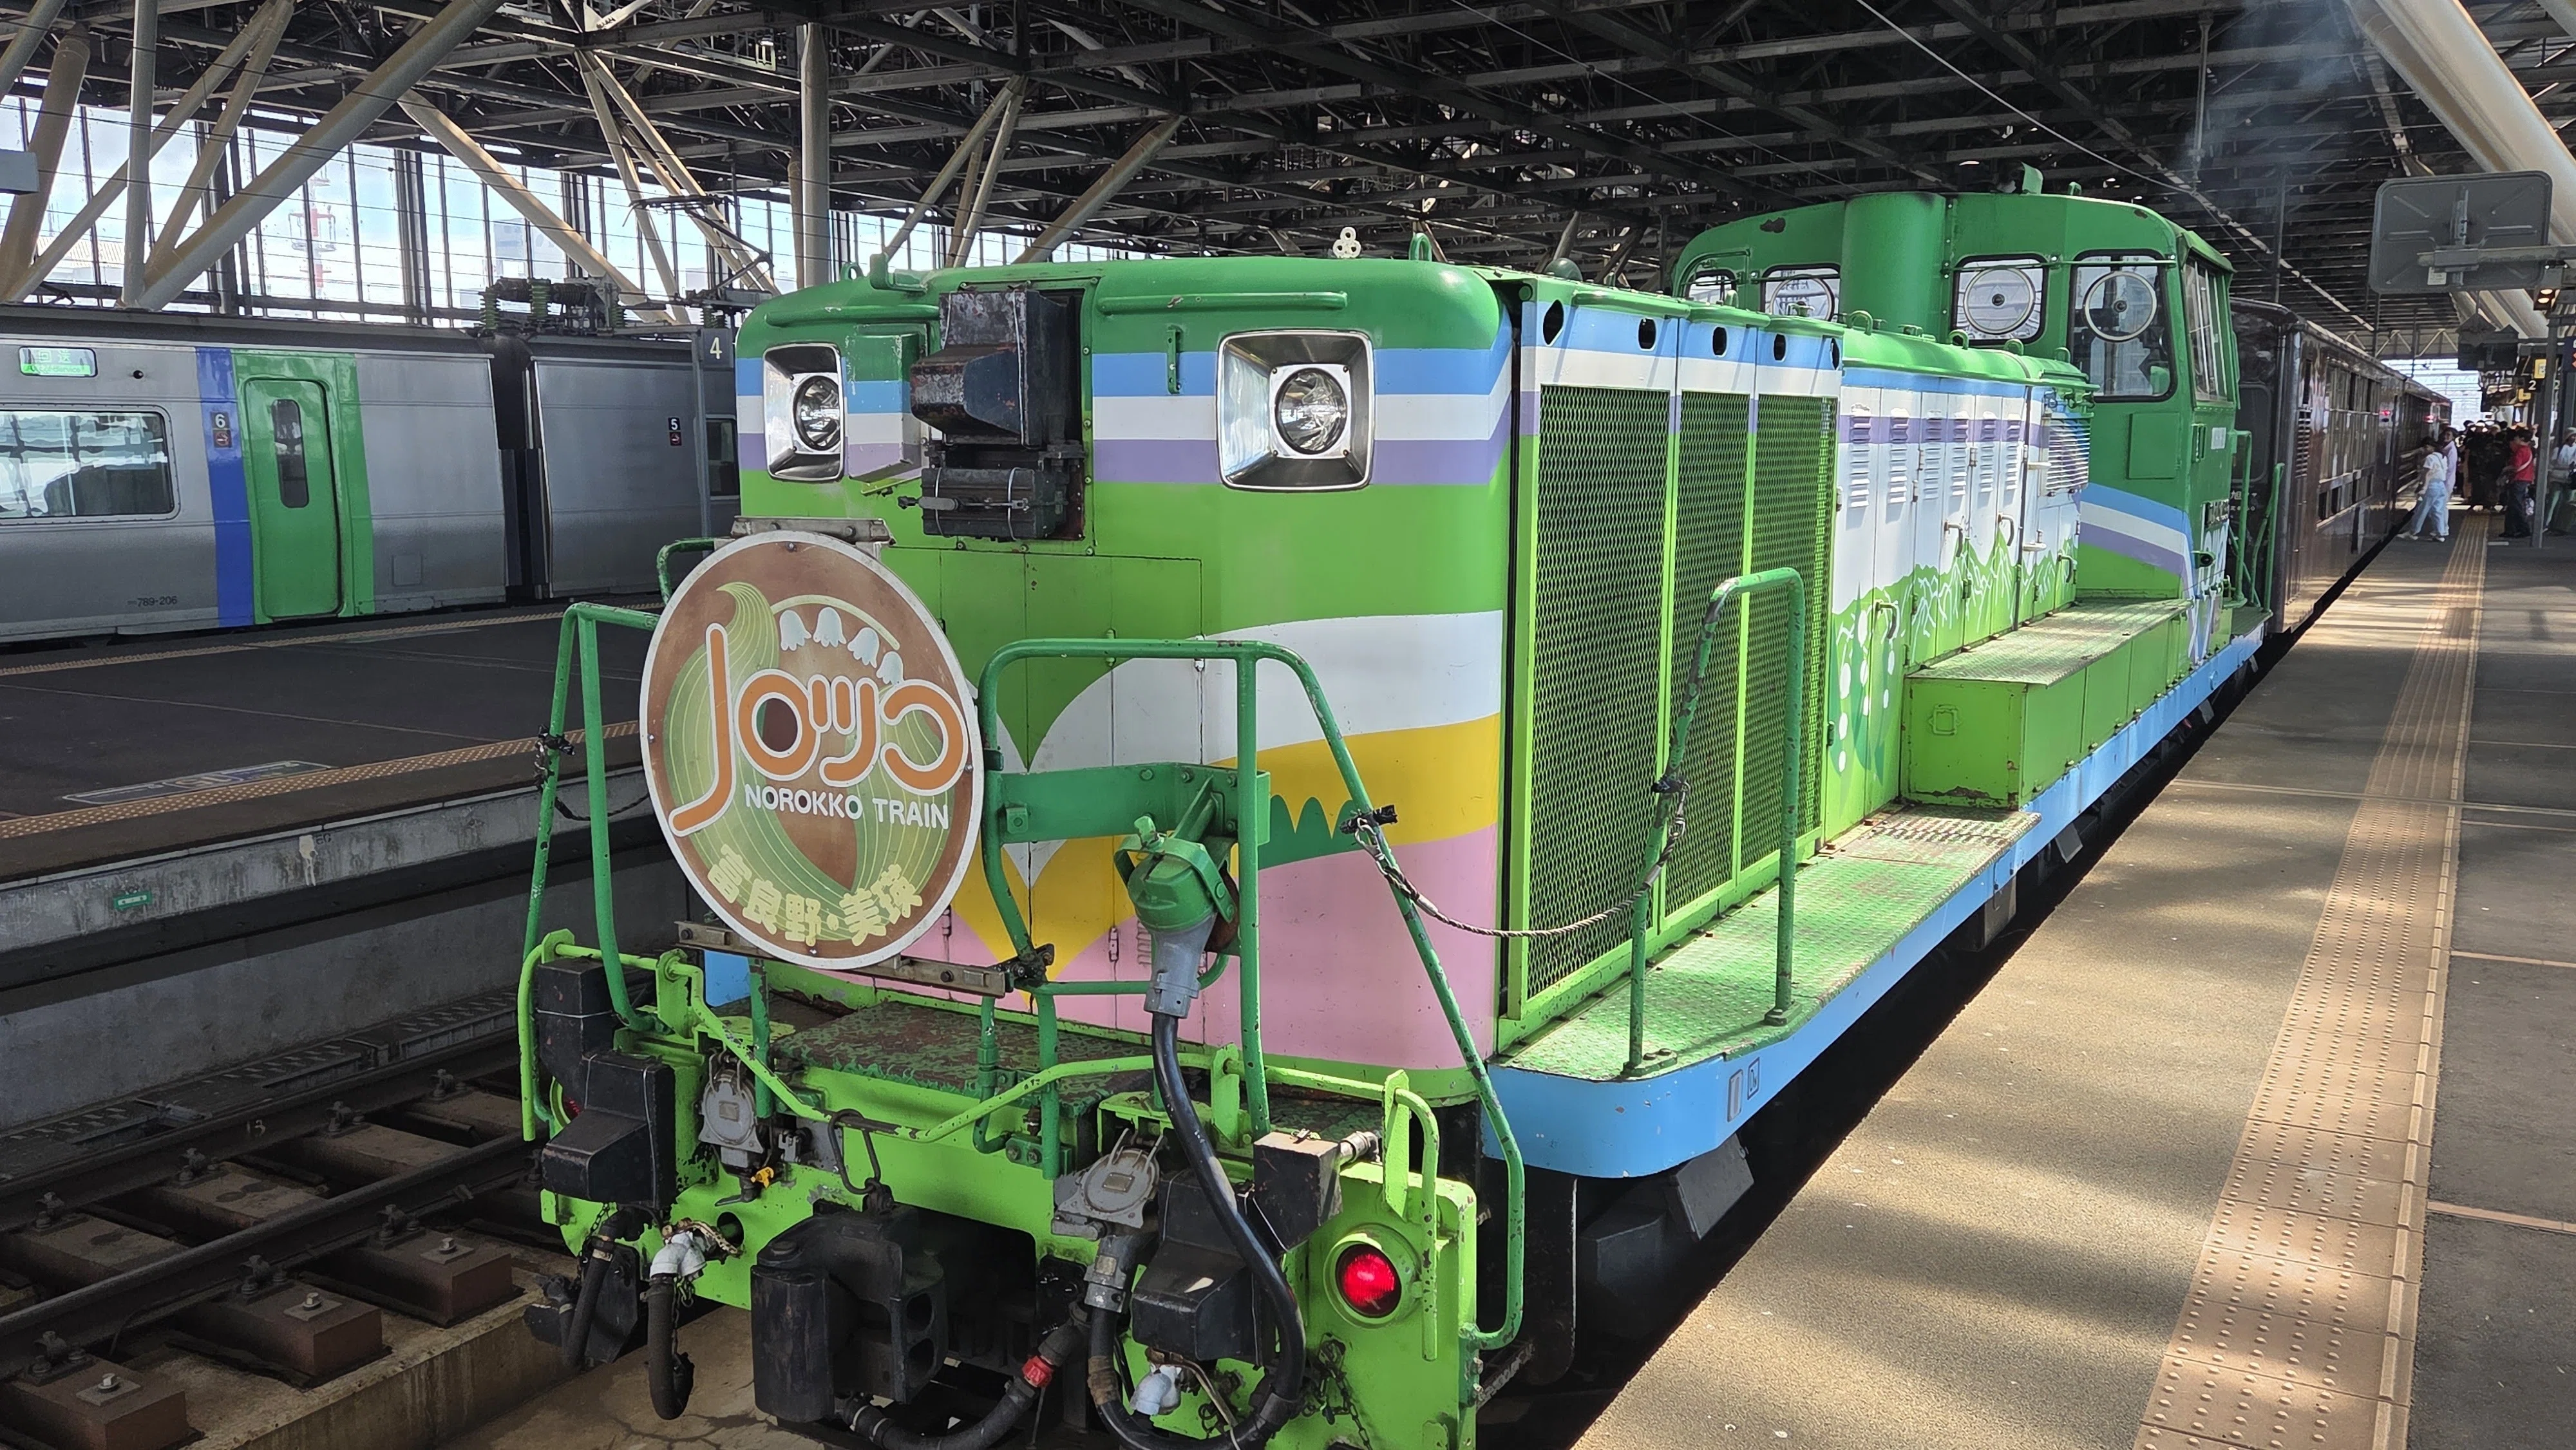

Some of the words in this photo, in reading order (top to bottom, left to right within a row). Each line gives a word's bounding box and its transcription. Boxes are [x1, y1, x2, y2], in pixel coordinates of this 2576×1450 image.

[710, 337, 723, 359] 4
[37, 350, 71, 364] 回送
[2528, 380, 2537, 390] 2
[215, 414, 225, 428] 6
[670, 419, 678, 430] 5
[745, 784, 864, 820] NOROKKO
[872, 797, 950, 830] TRAIN
[707, 843, 923, 946] 富良野・美瑛
